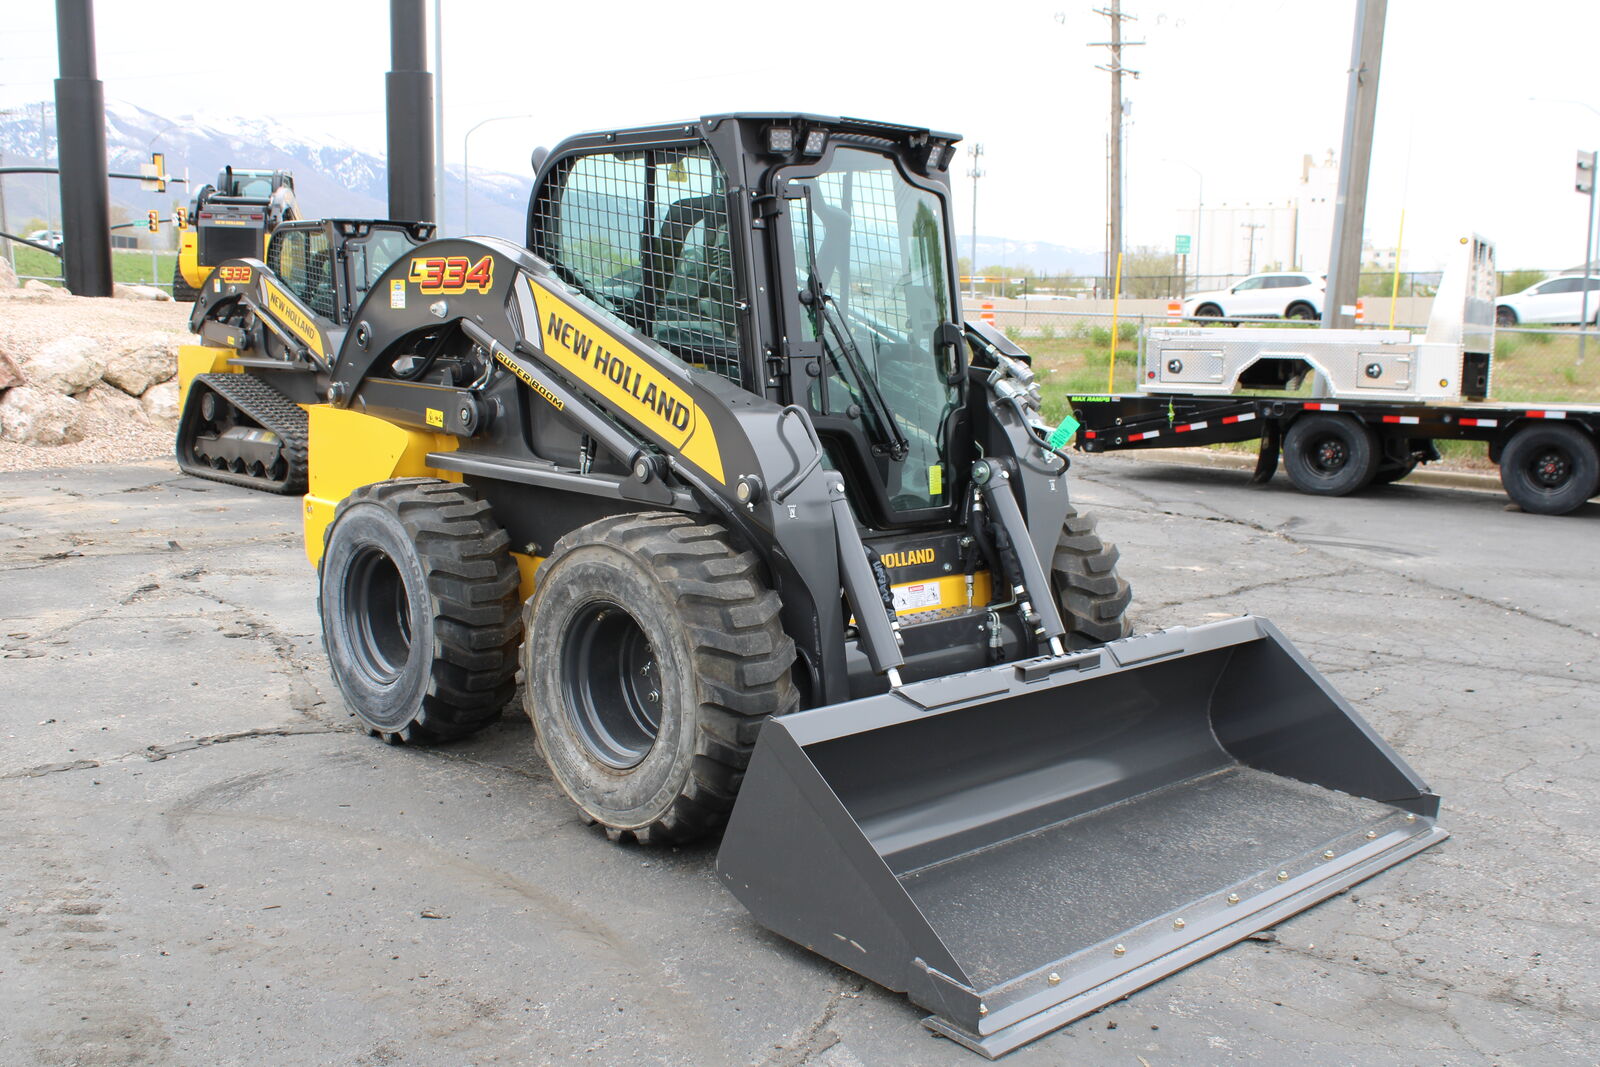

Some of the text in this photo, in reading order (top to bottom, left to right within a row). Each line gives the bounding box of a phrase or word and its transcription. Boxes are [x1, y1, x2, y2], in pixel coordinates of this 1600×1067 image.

[409, 256, 493, 292] L334
[271, 292, 286, 312] NEW
[285, 307, 315, 339] HOLLAND
[498, 352, 563, 408] SUPER BOOM
[547, 312, 690, 432] NEW HOLLAND
